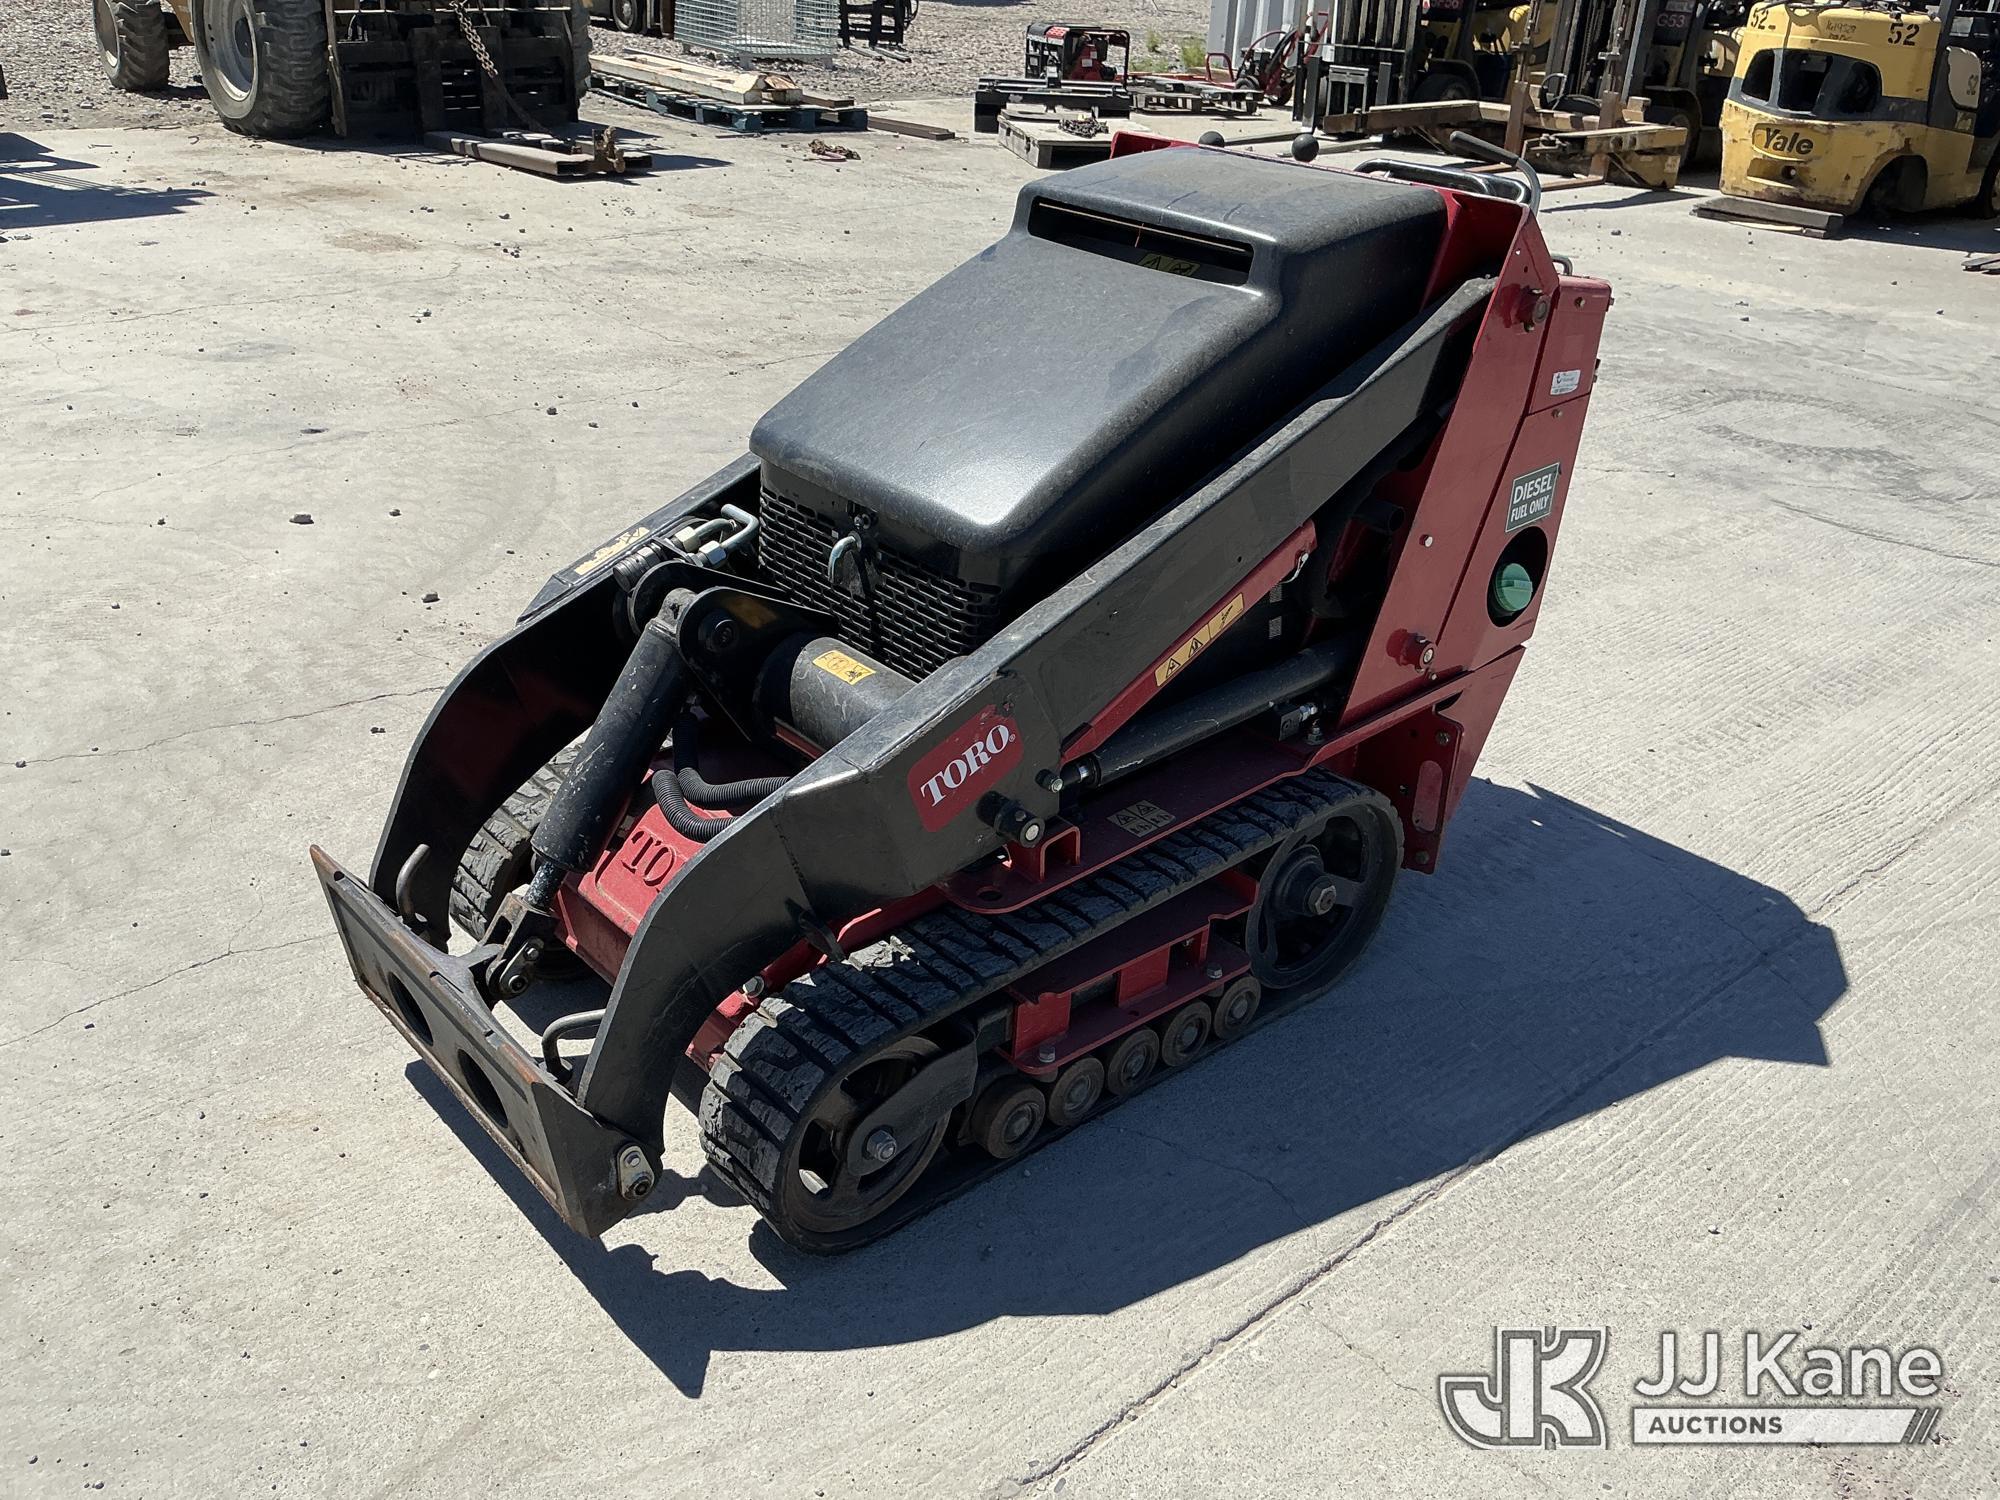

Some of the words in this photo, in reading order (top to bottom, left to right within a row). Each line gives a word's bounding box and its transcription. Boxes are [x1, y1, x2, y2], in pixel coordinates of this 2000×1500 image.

[1888, 22, 1920, 46] 52
[1764, 128, 1814, 155] Yale
[1513, 474, 1552, 504] DIESEL
[1511, 503, 1528, 522] FUEL
[1530, 495, 1550, 514] ONLY
[920, 725, 1010, 807] TORO
[621, 830, 677, 893] TO
